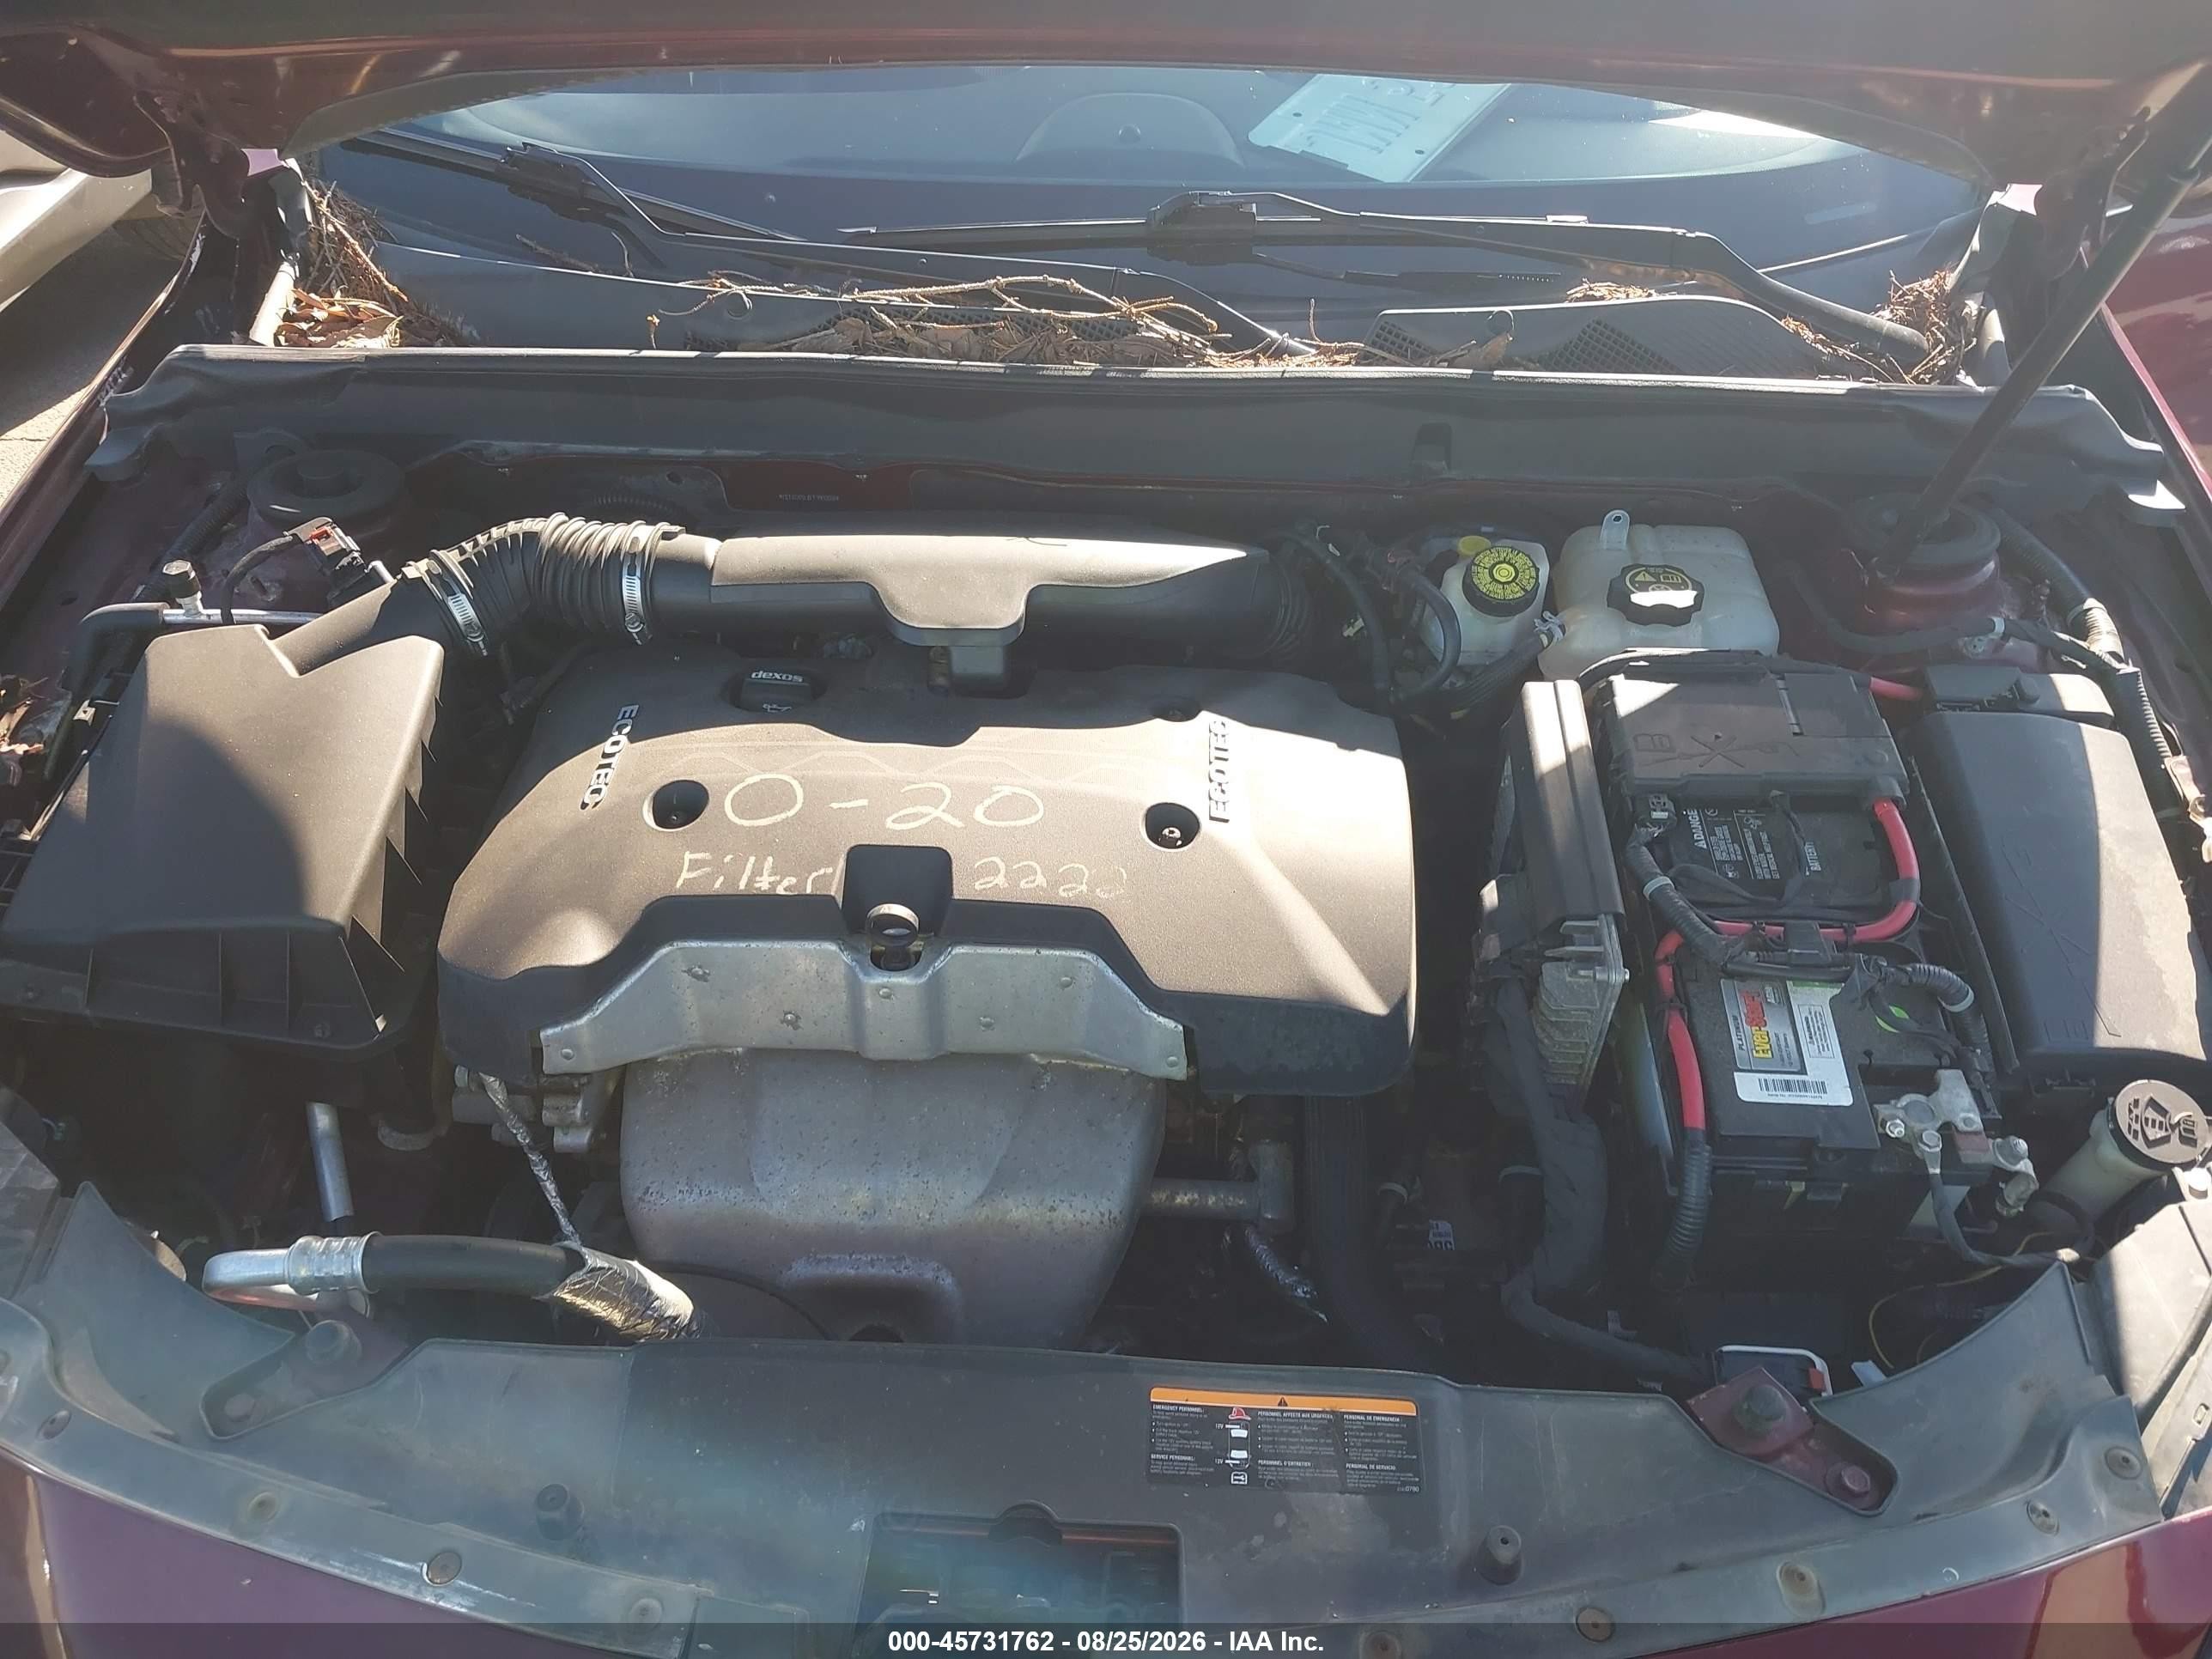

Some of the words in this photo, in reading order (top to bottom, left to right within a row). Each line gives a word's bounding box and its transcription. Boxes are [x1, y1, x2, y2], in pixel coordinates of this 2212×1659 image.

[750, 670, 804, 684] dexos
[582, 704, 639, 810] ECOTEC
[1208, 718, 1230, 823] ECOTEC
[1686, 809, 1704, 841] DANGE
[675, 850, 834, 895] Filter
